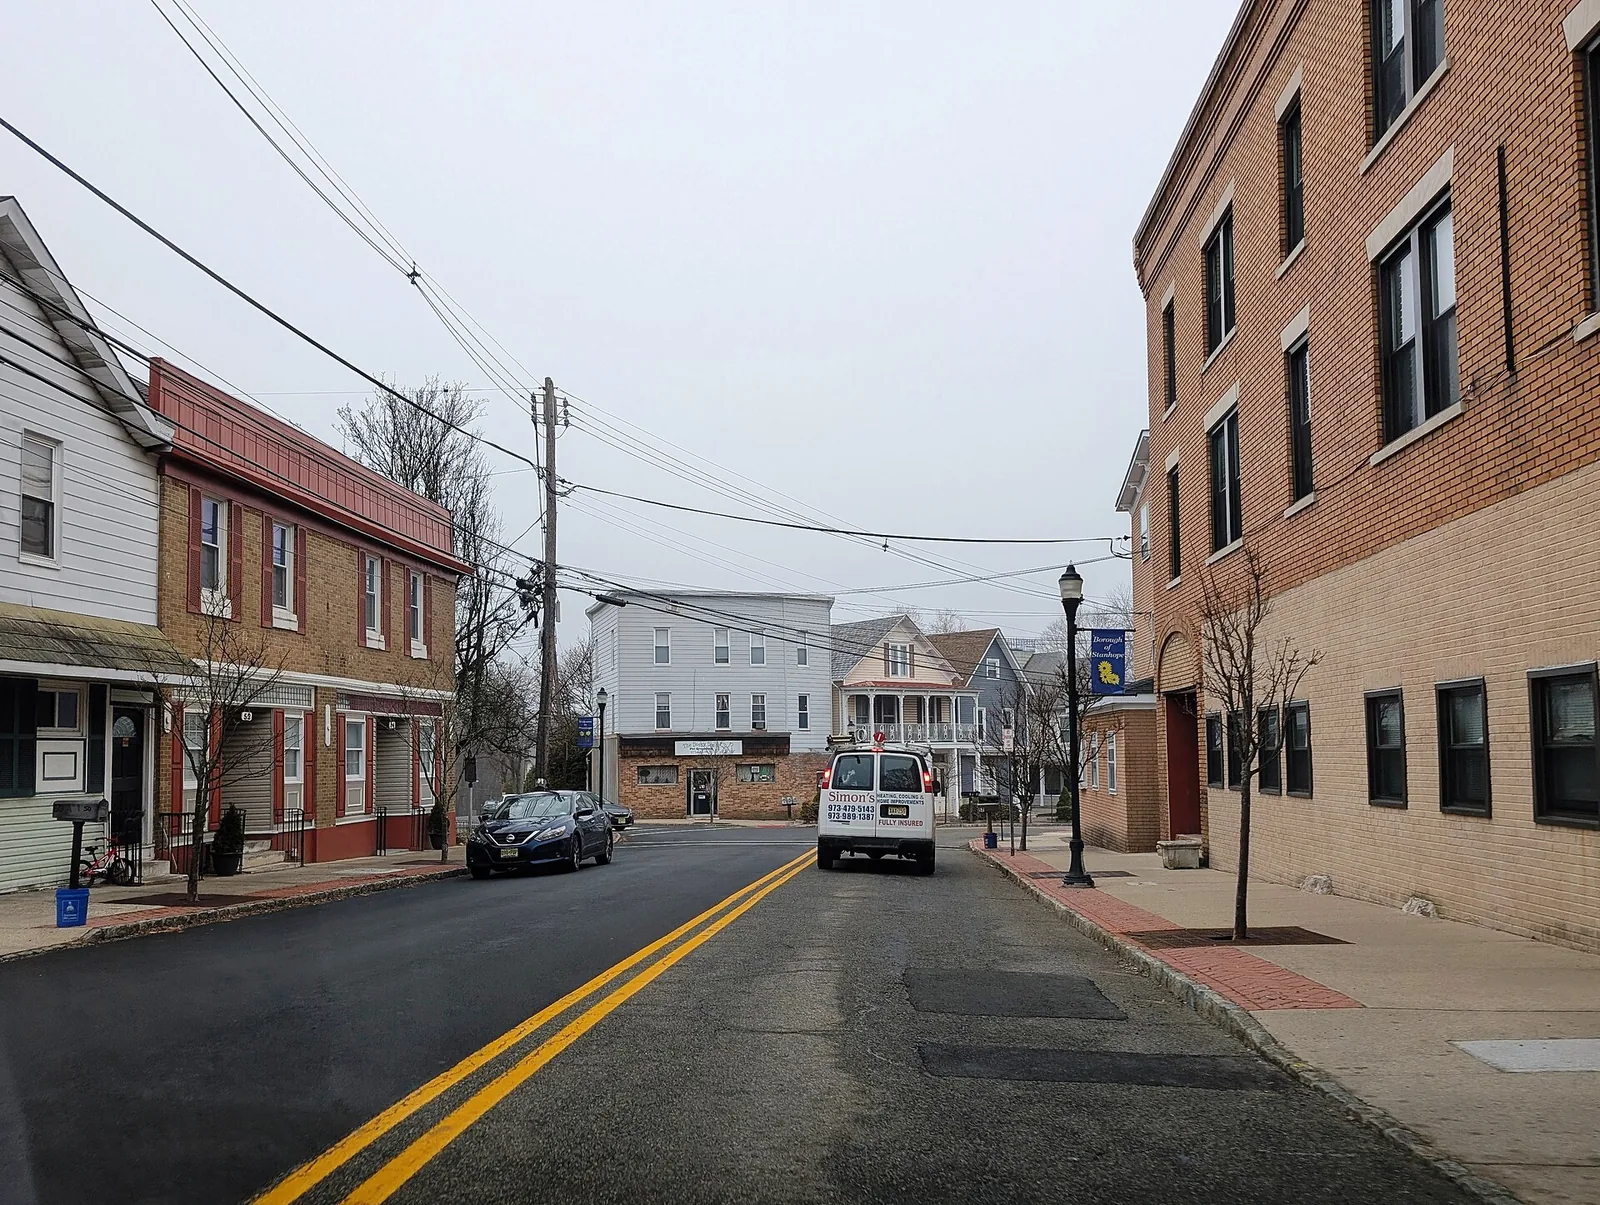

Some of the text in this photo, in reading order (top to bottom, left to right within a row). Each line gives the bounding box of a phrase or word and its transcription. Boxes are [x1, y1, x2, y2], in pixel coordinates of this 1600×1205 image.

[1093, 636, 1123, 644] Borough
[1091, 651, 1125, 659] Stanhope
[828, 791, 876, 803] Simon's
[827, 804, 875, 813] 973-479-5143
[827, 812, 875, 821] 973-989-1387
